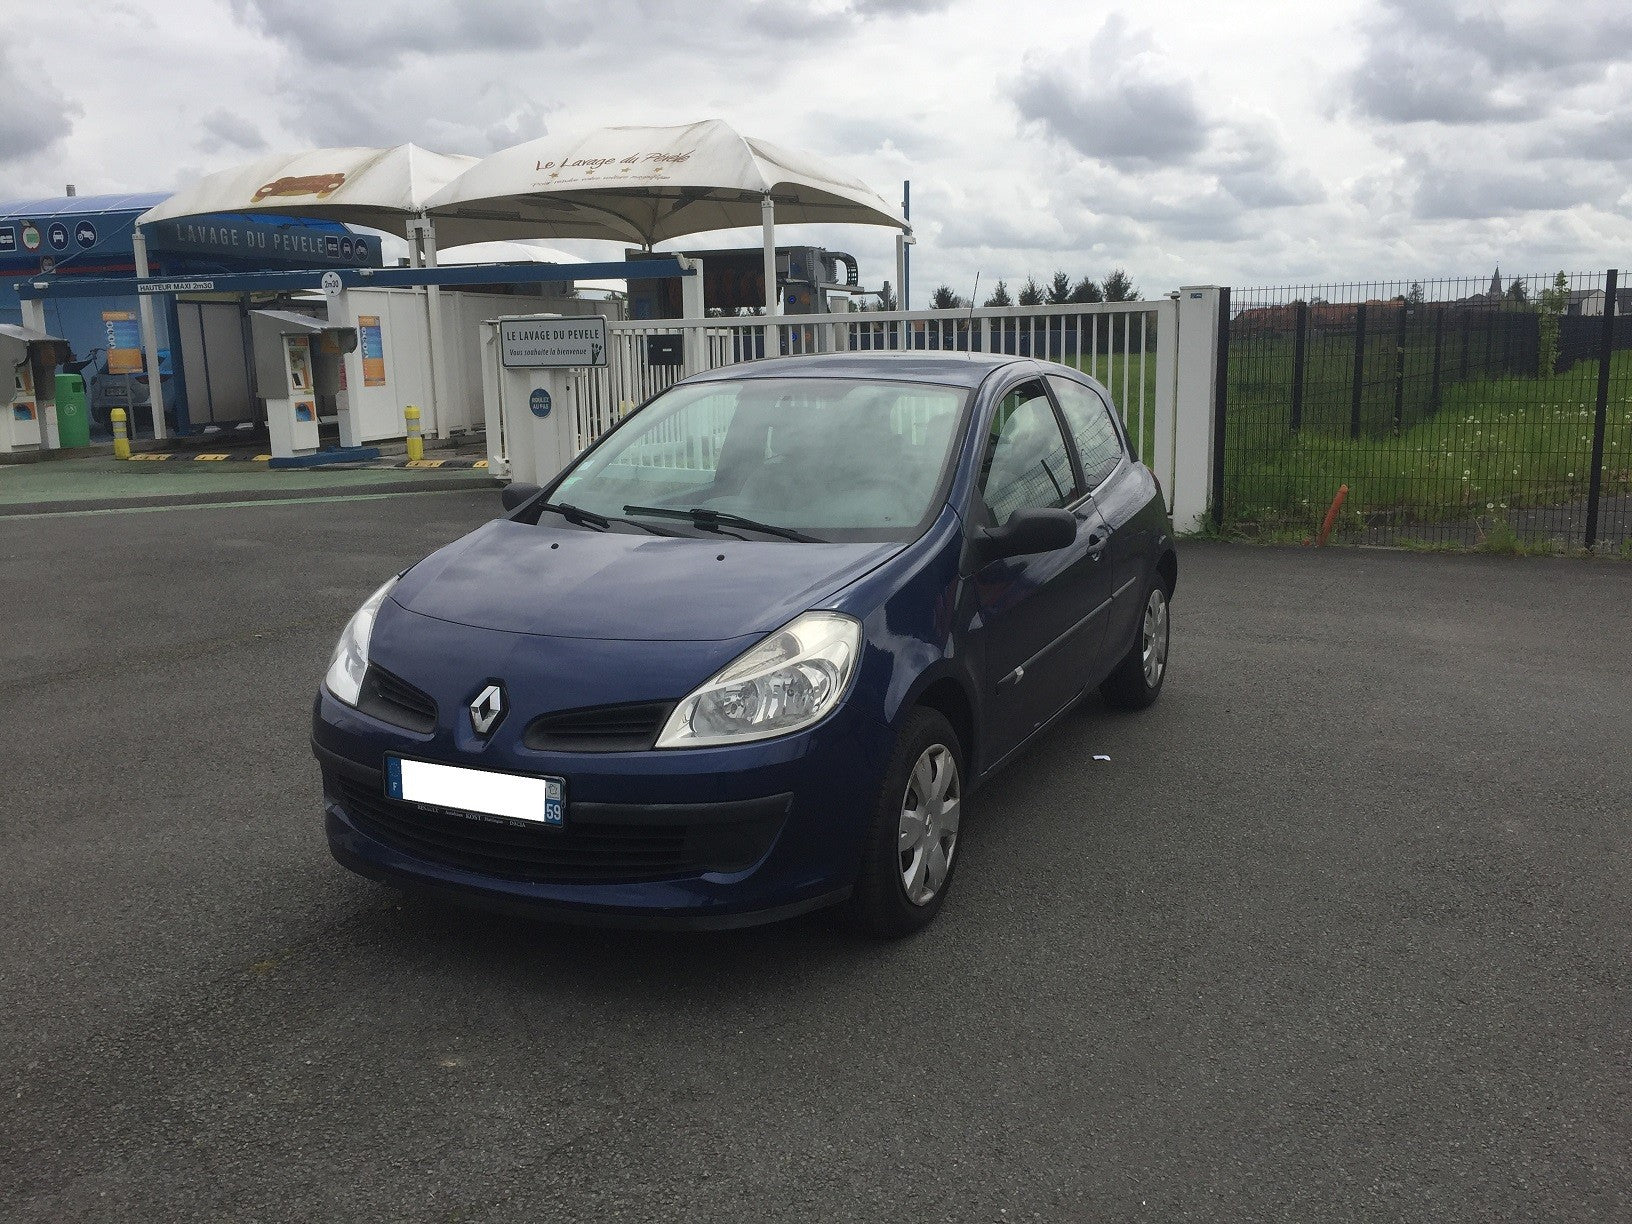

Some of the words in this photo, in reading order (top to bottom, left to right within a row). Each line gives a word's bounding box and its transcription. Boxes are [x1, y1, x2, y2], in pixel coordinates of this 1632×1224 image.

[535, 160, 555, 171] Le
[560, 157, 616, 169] Lavage
[619, 152, 640, 164] du
[176, 223, 238, 246] LAVAGE
[247, 230, 266, 249] DU
[274, 233, 324, 254] PEVELE
[140, 282, 172, 292] HAUTEUR
[173, 282, 192, 291] MAXI
[193, 281, 213, 290] 2m30
[324, 279, 340, 289] 2m30
[506, 331, 516, 341] LE
[519, 330, 550, 341] LAVAGE
[553, 330, 565, 340] DU
[568, 329, 600, 339] PEVELE
[509, 348, 523, 356] Vous
[524, 347, 549, 356] souhaite
[549, 347, 556, 356] la
[557, 347, 587, 356] bienvenue
[392, 781, 398, 791] F
[546, 803, 561, 821] 59
